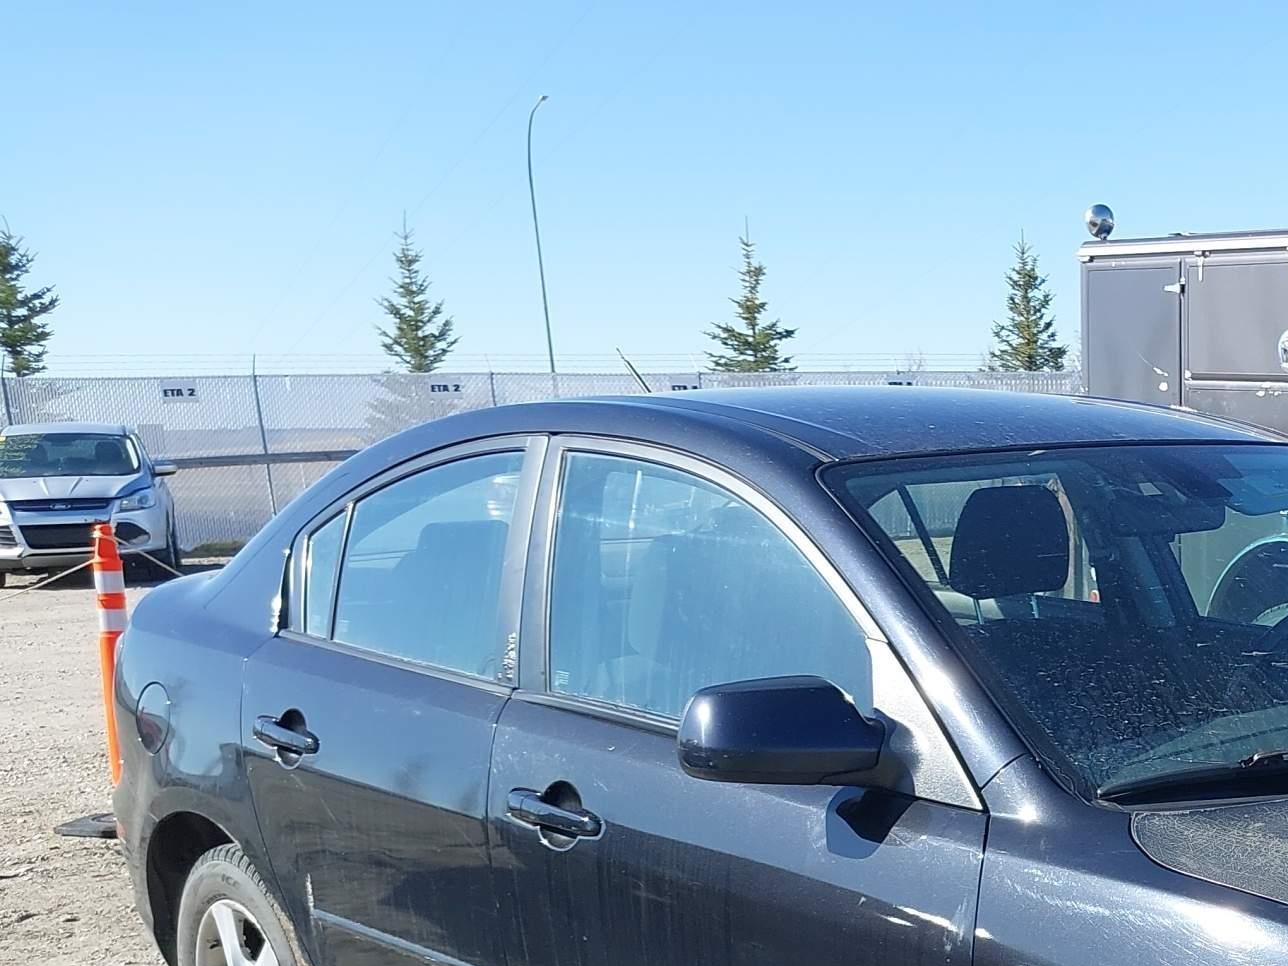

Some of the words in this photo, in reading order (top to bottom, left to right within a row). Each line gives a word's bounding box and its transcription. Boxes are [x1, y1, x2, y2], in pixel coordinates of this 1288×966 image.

[452, 384, 461, 392] 2
[163, 388, 184, 397] ETA
[187, 388, 196, 397] 2
